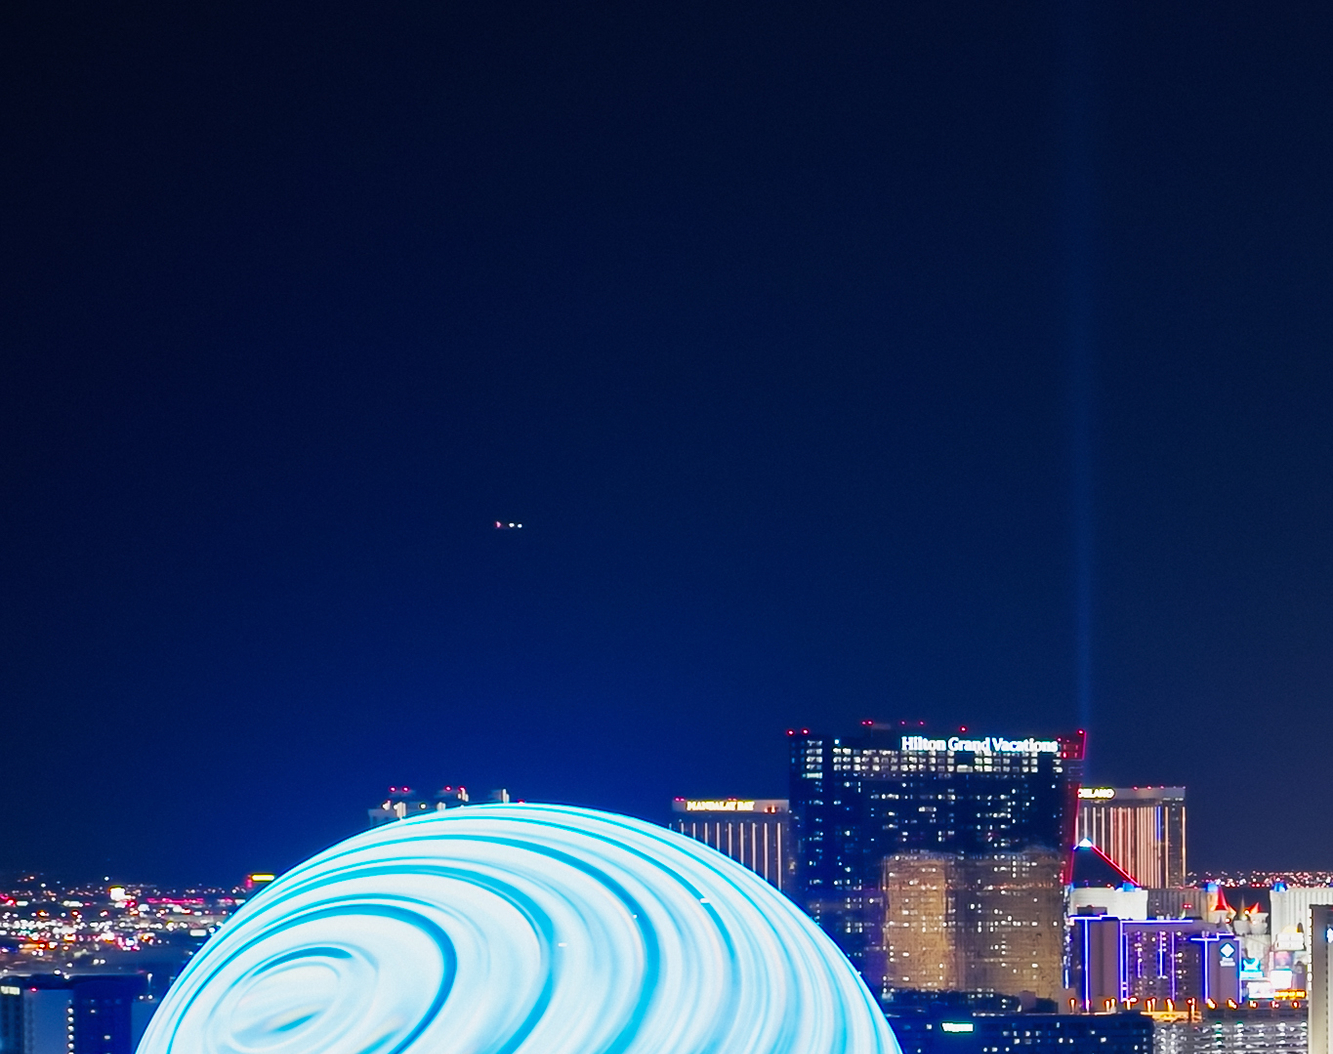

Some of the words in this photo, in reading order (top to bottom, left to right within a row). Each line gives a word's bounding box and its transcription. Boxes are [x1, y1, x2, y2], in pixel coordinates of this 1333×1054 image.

[901, 735, 947, 751] Hilton
[947, 736, 990, 752] Grand
[992, 737, 1058, 753] Vacations
